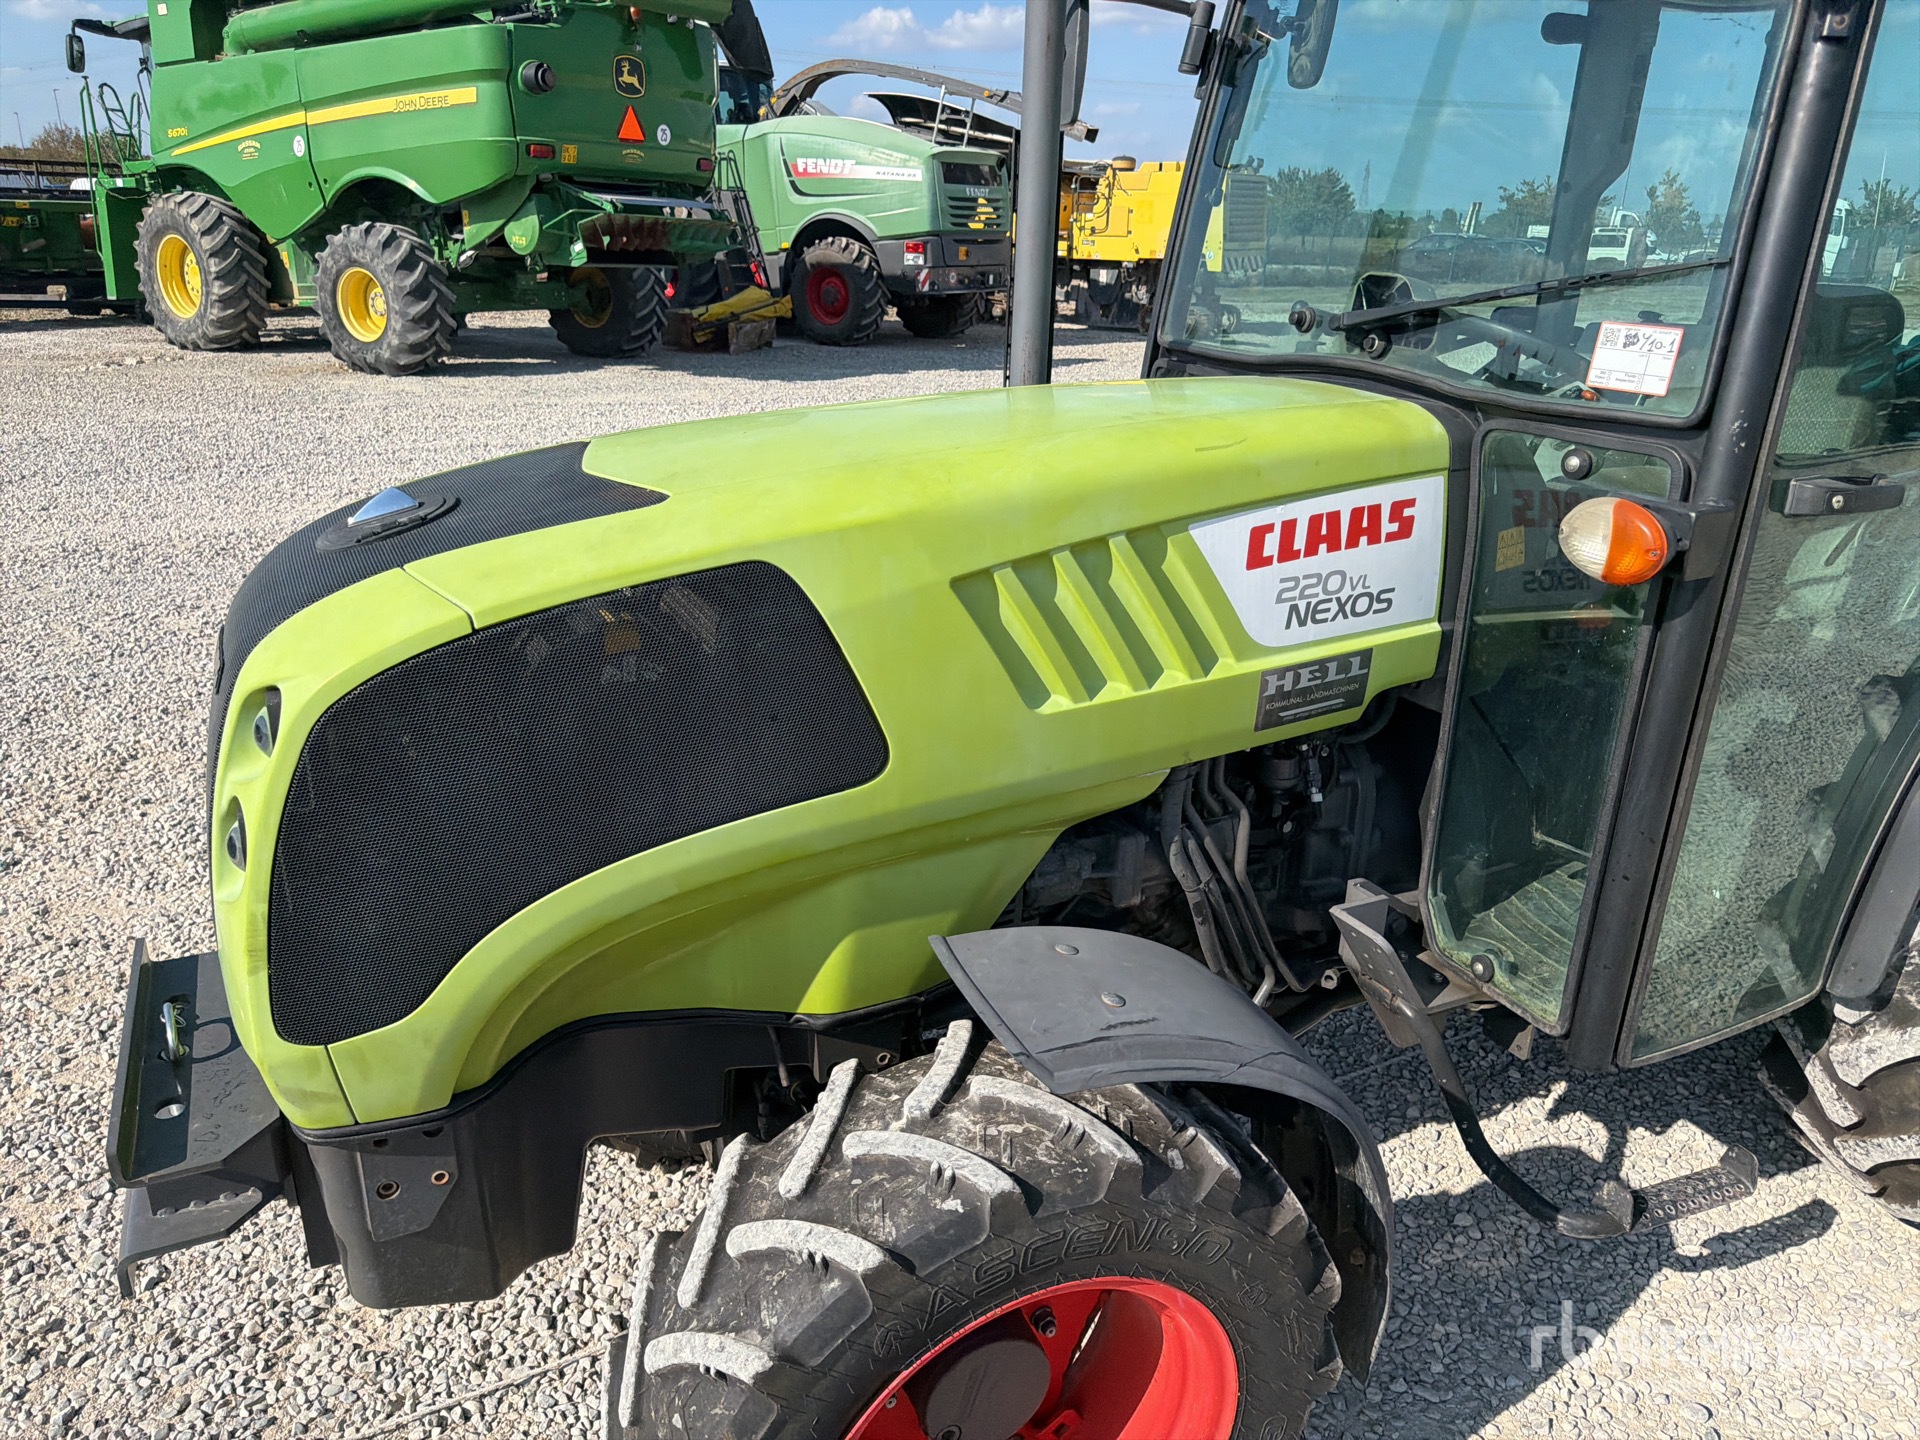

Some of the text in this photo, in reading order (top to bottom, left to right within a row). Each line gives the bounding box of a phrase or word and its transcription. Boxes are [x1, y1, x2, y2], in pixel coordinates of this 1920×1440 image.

[393, 95, 449, 111] JOHN DEERE
[167, 126, 188, 138] S670i
[661, 128, 668, 143] 25
[796, 157, 857, 175] FENDT
[876, 170, 905, 178] KATANA
[965, 186, 990, 197] FENDT
[1245, 497, 1418, 571] CLAAS
[1274, 569, 1372, 605] 220 VL
[1284, 587, 1396, 631] NEXOS
[1262, 655, 1369, 697] HELL
[921, 1216, 1232, 1332] ASCENSO
